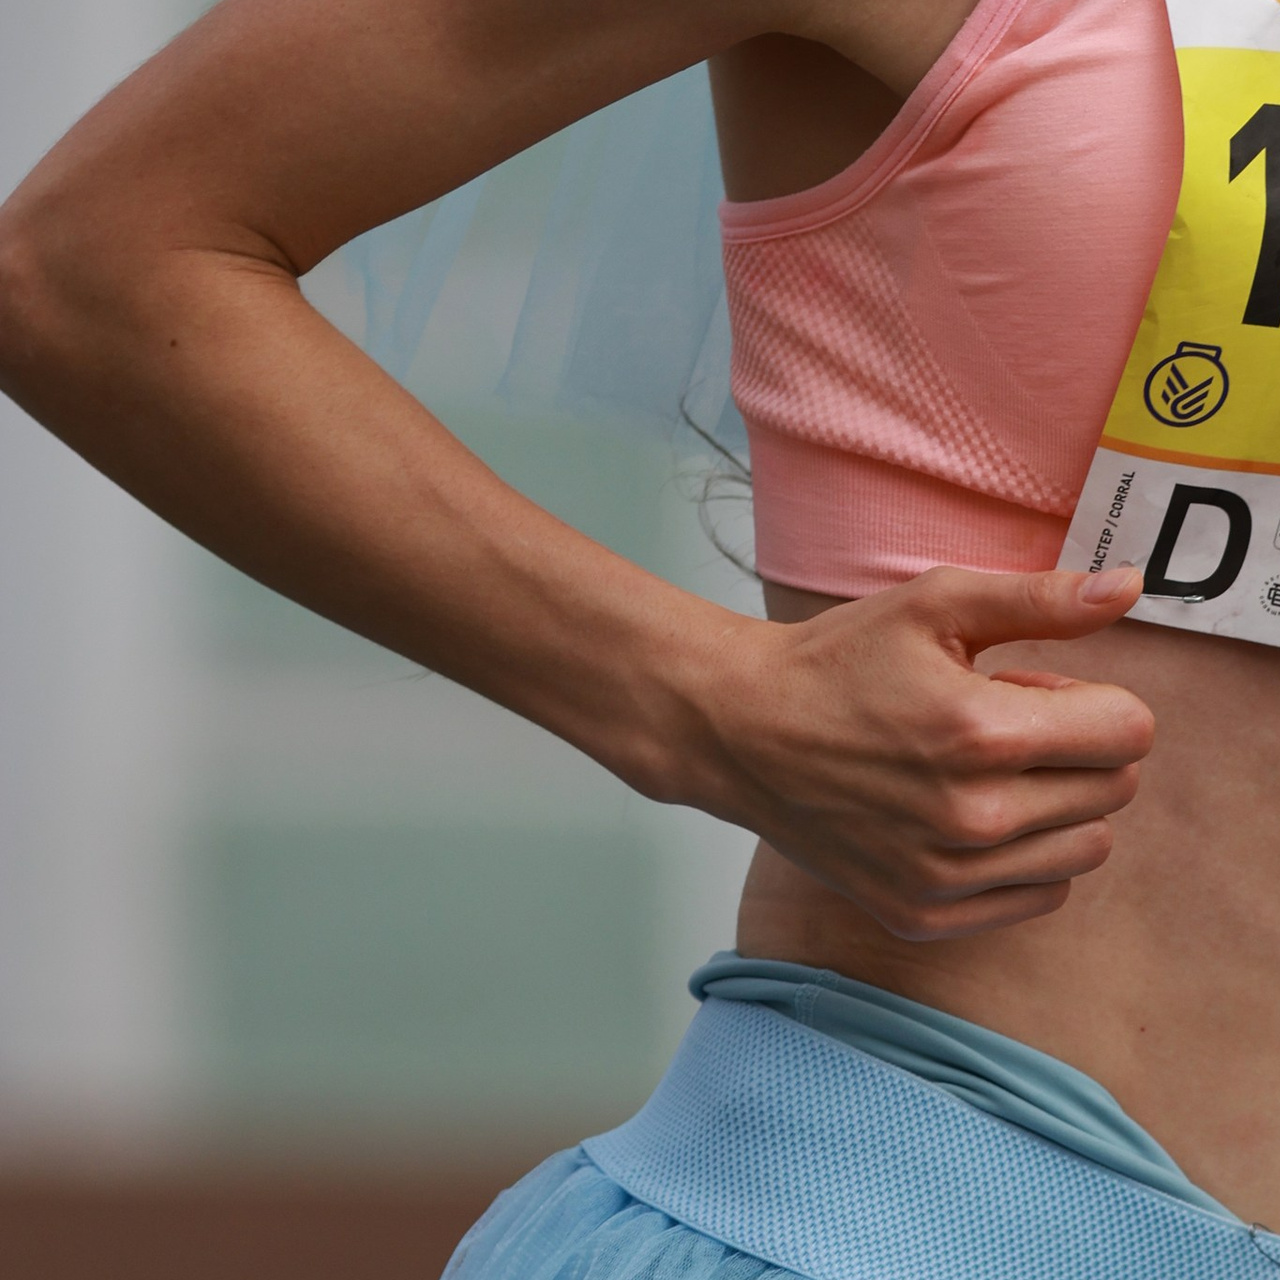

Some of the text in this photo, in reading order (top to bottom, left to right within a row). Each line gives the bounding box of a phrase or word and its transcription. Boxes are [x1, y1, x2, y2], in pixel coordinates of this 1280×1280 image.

[1089, 526, 1114, 573] ЛАСТЕР
[1109, 471, 1135, 519] CORRAL
[1143, 483, 1252, 602] D
